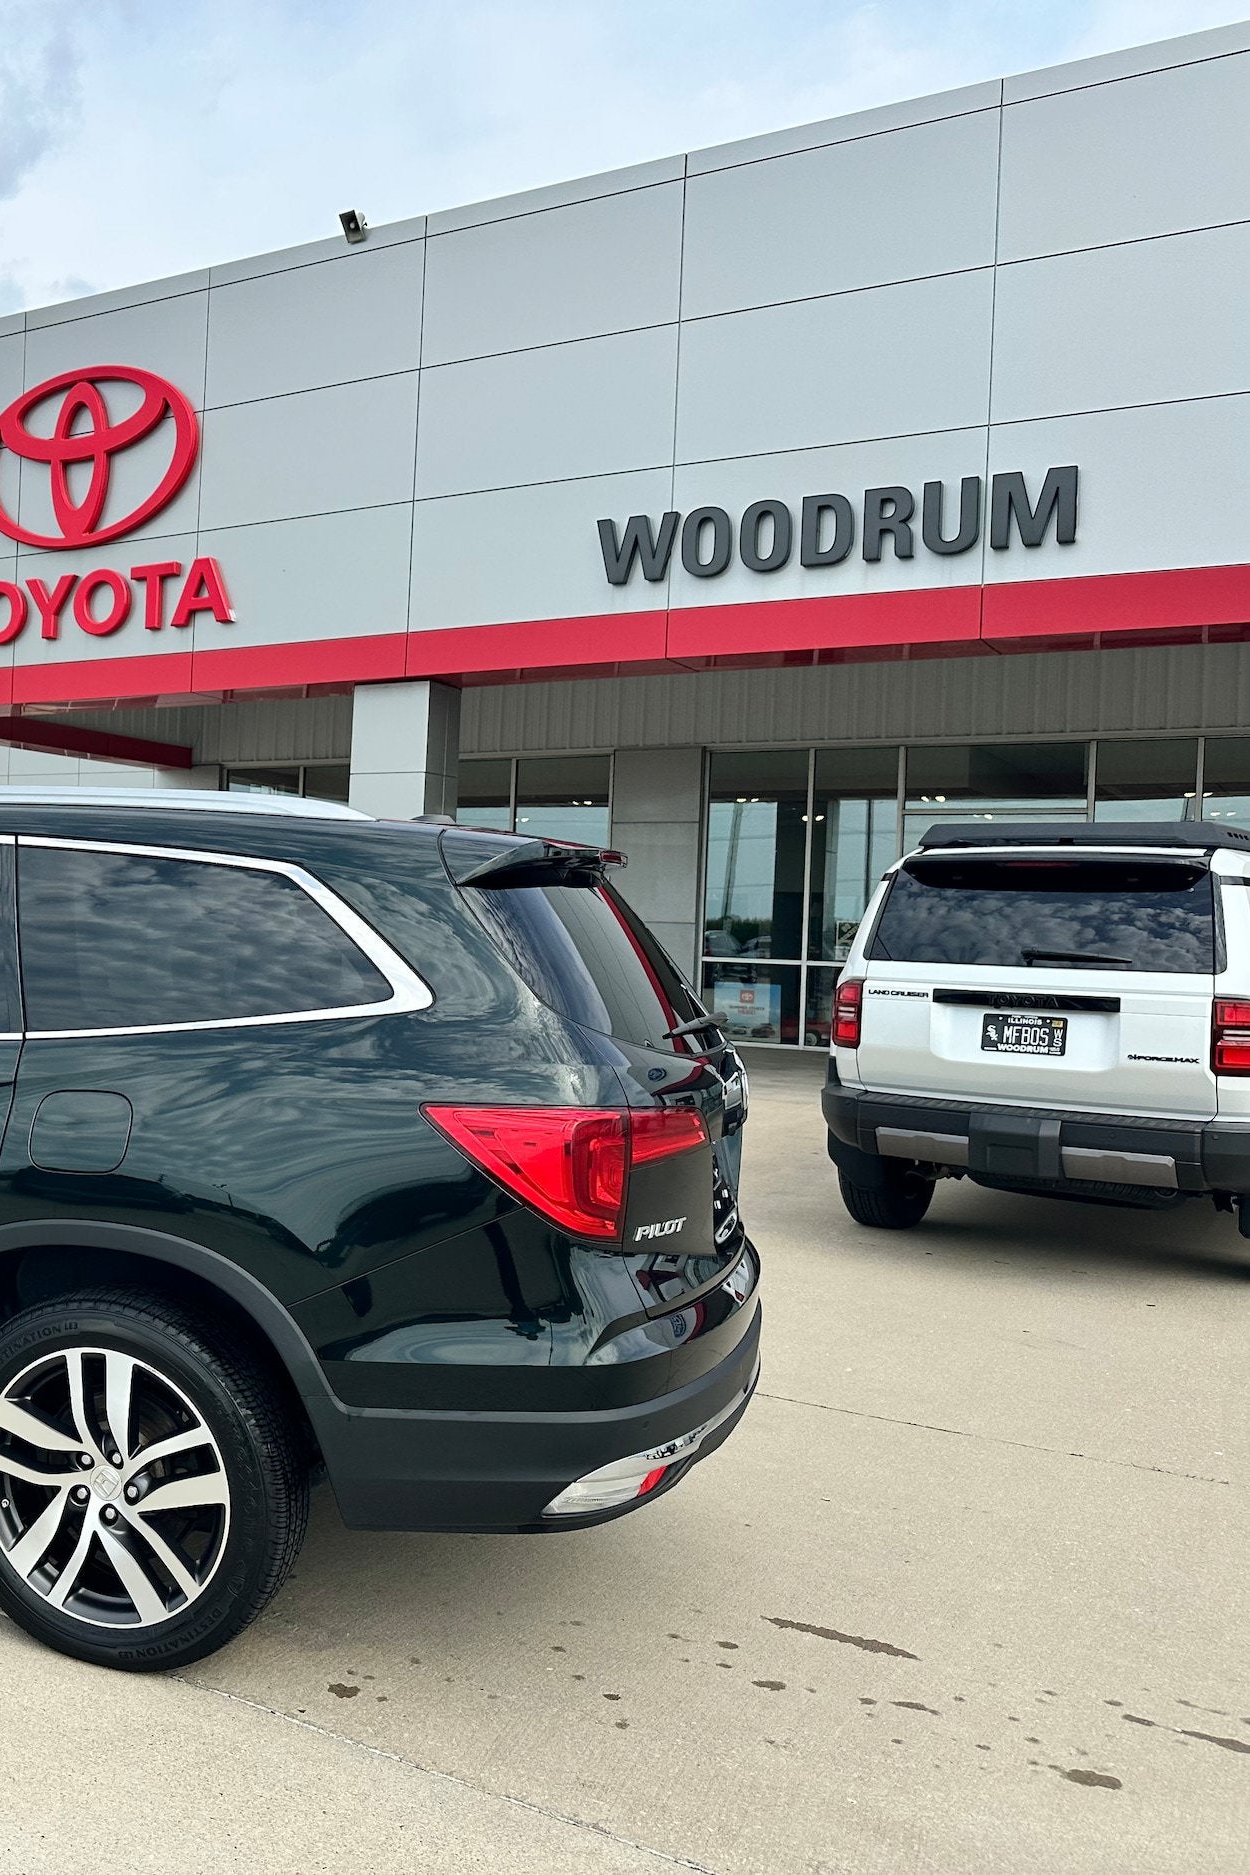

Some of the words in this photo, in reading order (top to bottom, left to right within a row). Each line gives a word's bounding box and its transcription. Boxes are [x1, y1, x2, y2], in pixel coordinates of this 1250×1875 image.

[597, 465, 1079, 586] WOODRUM
[890, 990, 929, 998] CRUISER
[989, 993, 1060, 1008] TOYOTA
[1008, 1017, 1043, 1025] ILLINOIS
[997, 1043, 1049, 1054] WOODRUM
[633, 1216, 687, 1242] PILOT
[136, 1607, 223, 1658] DESTINATION
